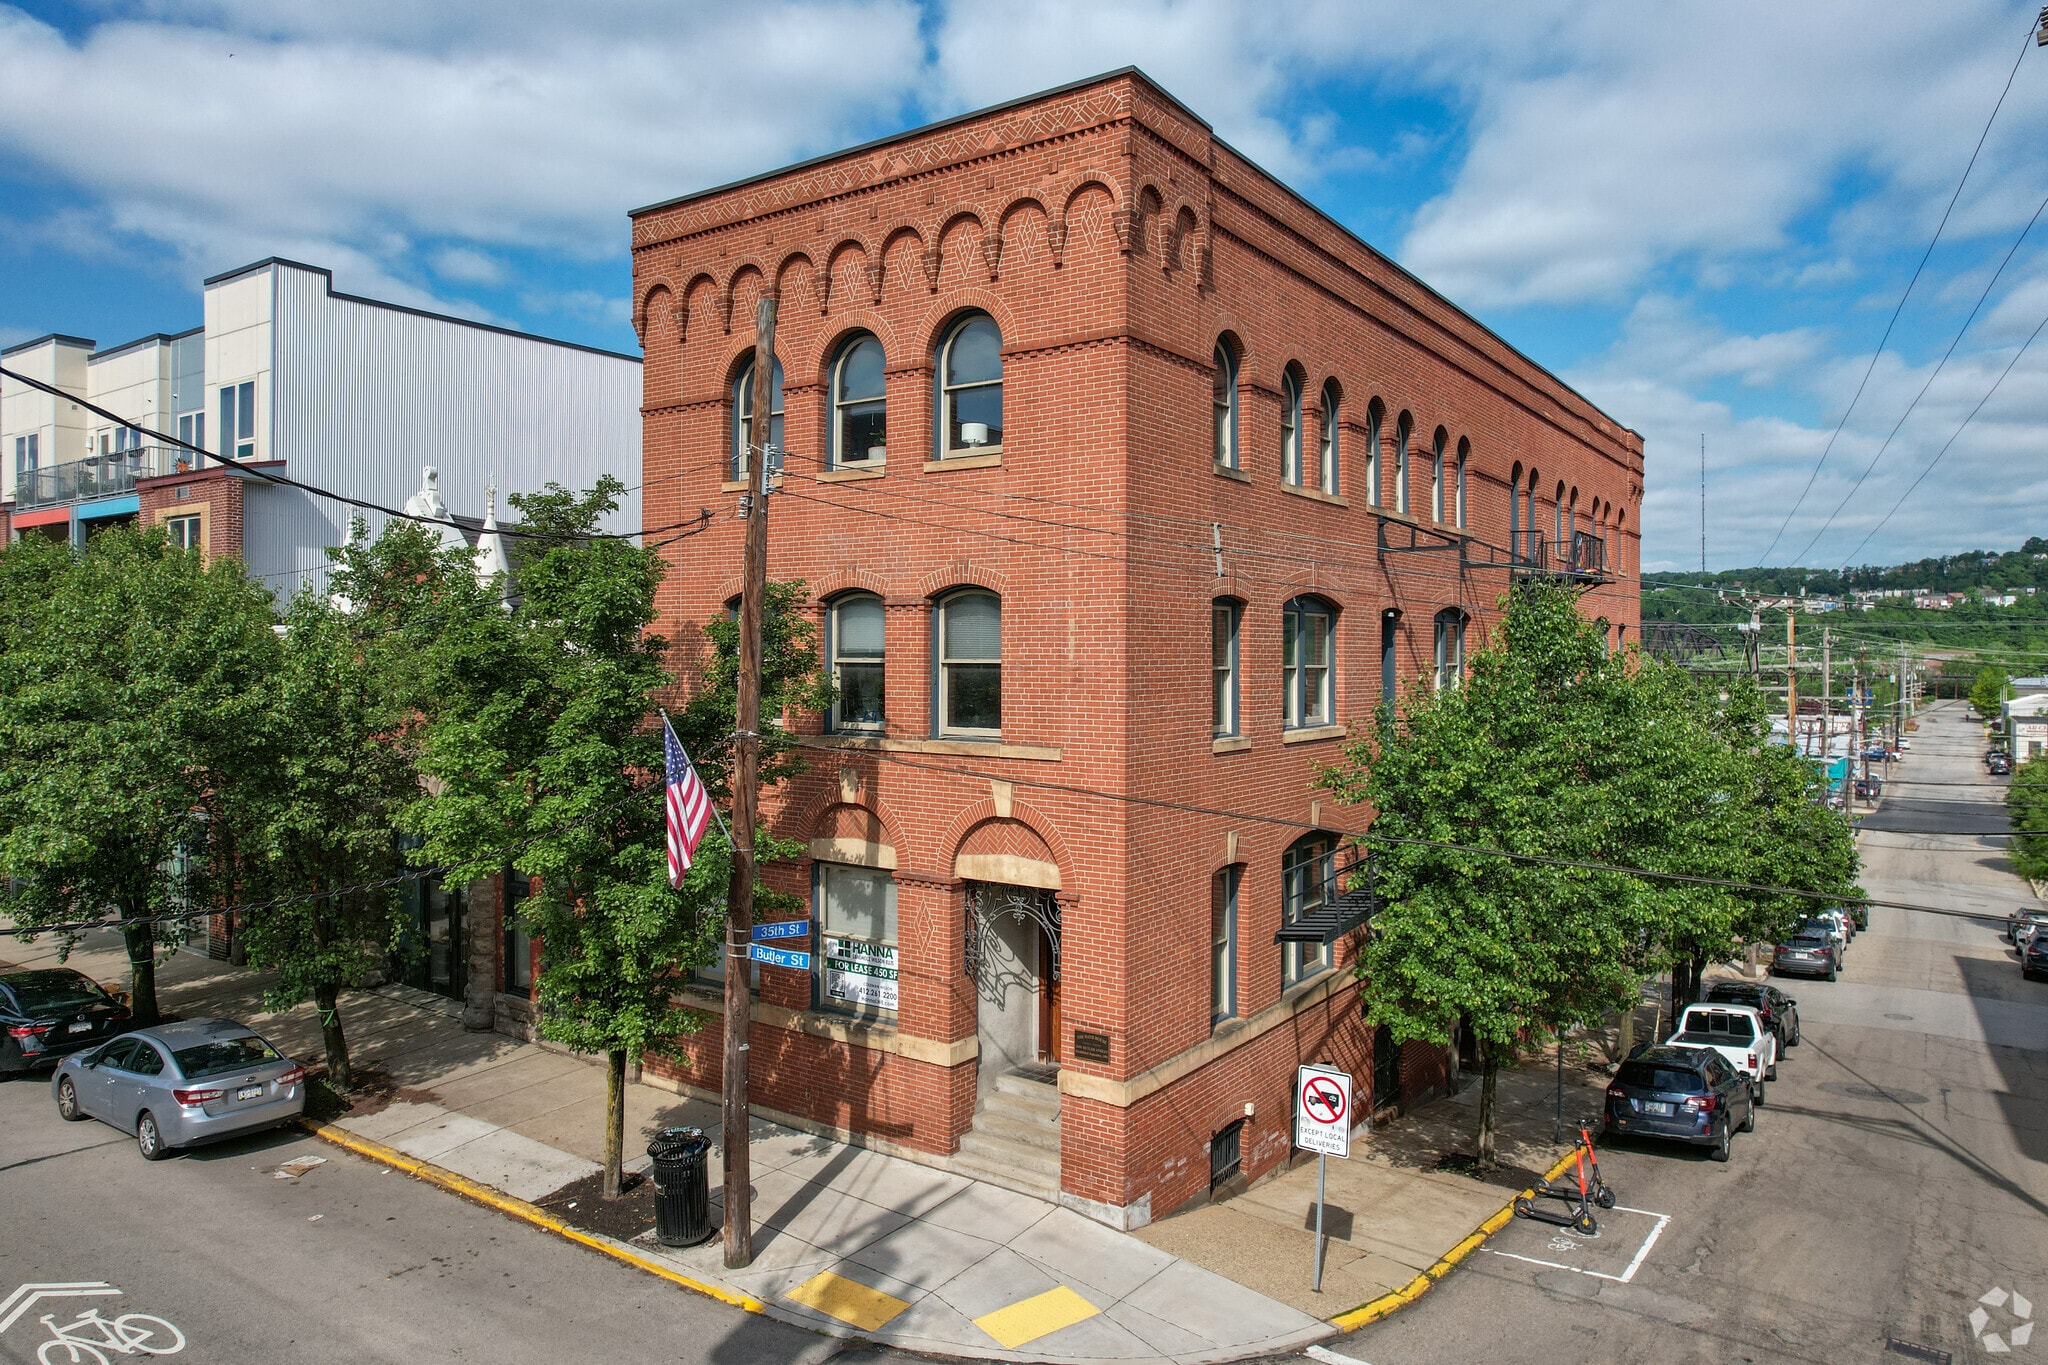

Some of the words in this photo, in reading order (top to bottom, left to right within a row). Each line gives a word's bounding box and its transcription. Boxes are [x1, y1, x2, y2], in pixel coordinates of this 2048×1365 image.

[761, 926, 784, 937] 35th
[789, 924, 799, 935] St
[756, 948, 785, 964] Butler
[791, 954, 803, 966] St
[852, 942, 894, 959] HANNA
[835, 960, 849, 971] FOR
[851, 963, 873, 975] LEASE
[874, 968, 888, 977] 450
[889, 970, 898, 980] SF
[859, 987, 897, 1000] 412.2612200
[1300, 1126, 1323, 1137] EXCEPT
[1324, 1132, 1345, 1142] LOCAL
[1304, 1137, 1341, 1151] DELIVERIES
